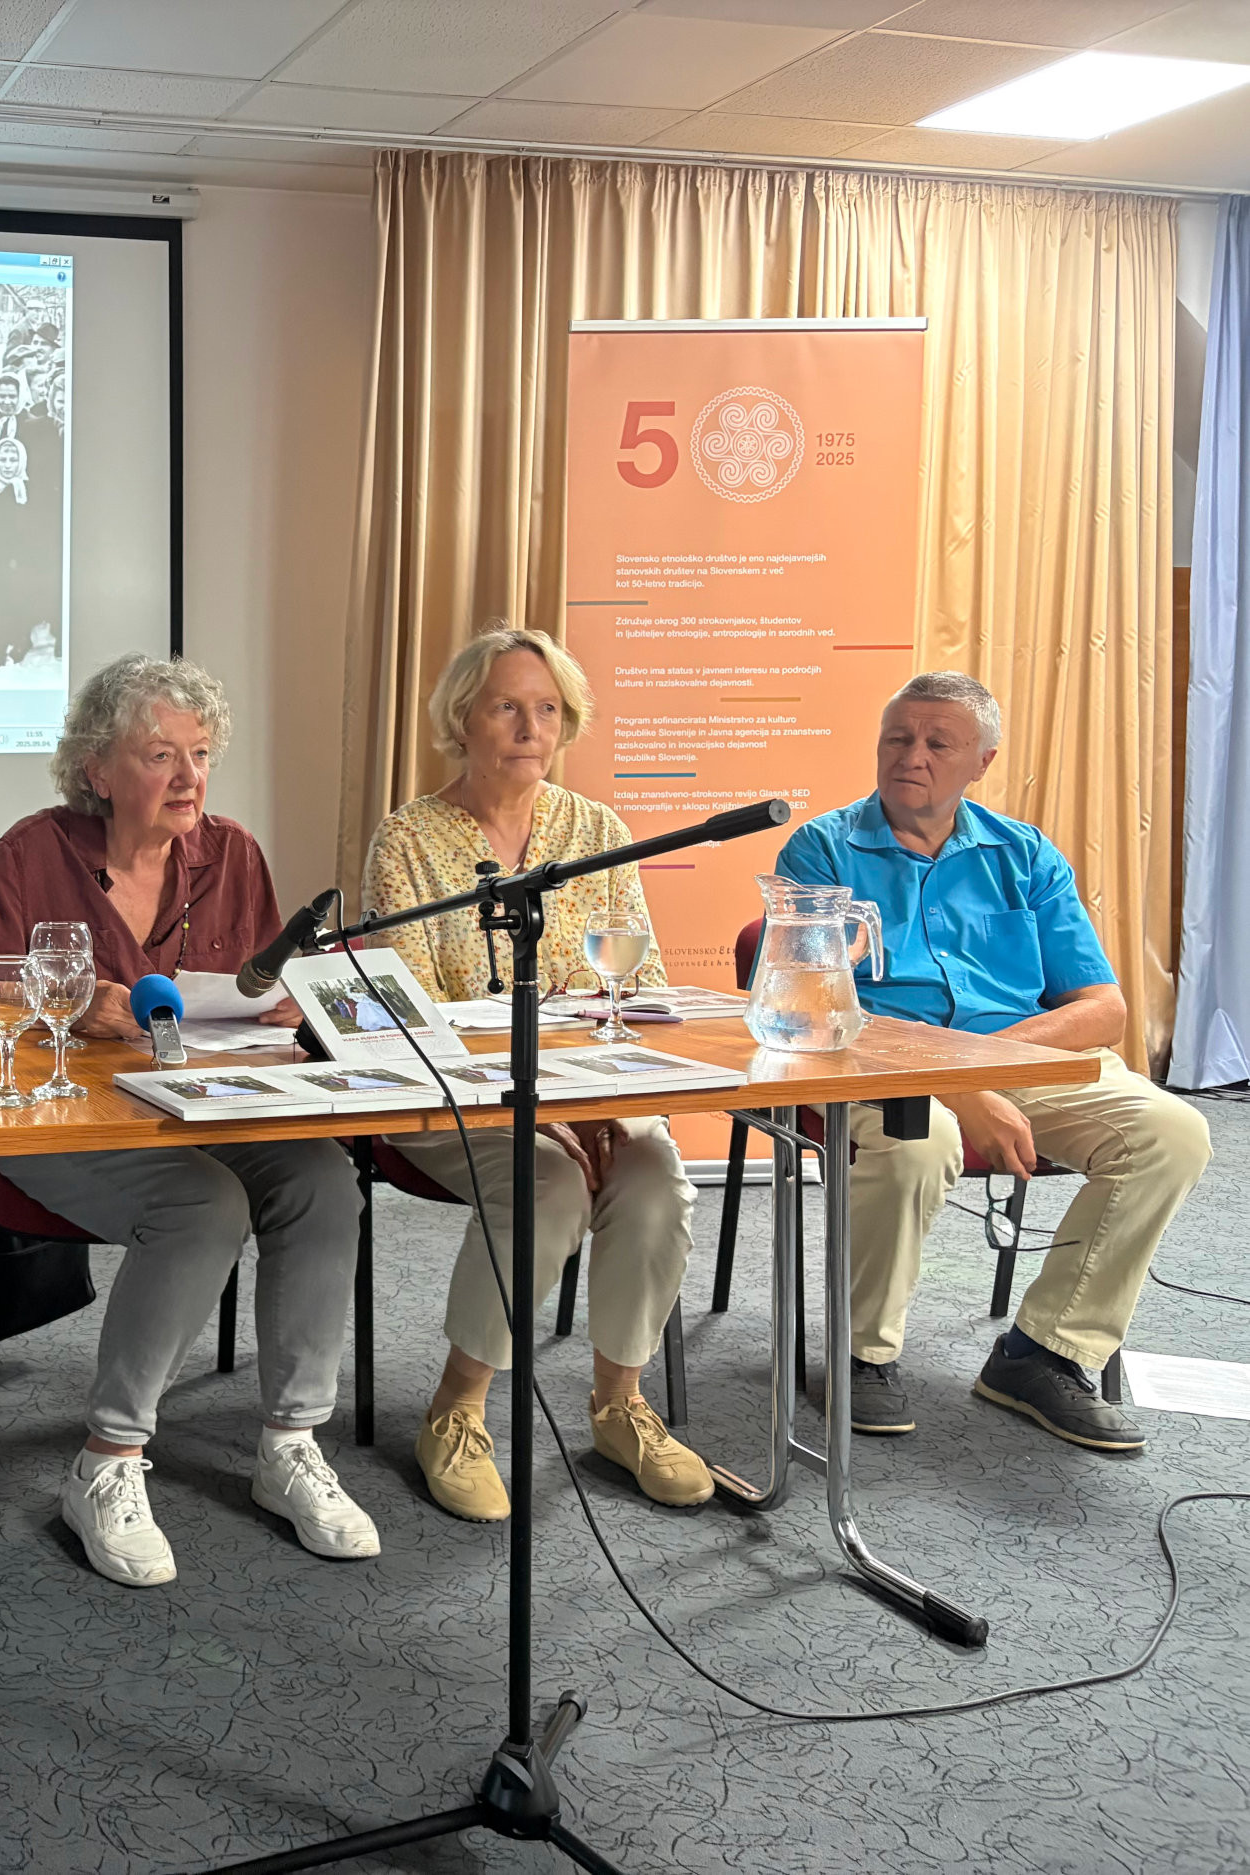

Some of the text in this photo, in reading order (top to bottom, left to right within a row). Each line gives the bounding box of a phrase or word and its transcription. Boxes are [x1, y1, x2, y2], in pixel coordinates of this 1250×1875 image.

[816, 433, 855, 447] 1975
[815, 452, 854, 466] 2025
[616, 554, 660, 563] Slovensko
[661, 554, 703, 563] etnološko
[705, 554, 738, 563] društvo
[739, 554, 747, 564] je
[766, 553, 827, 564] najdejavnejših
[616, 567, 661, 576] stanovskih
[663, 566, 695, 576] društev
[710, 567, 760, 575] Slovenskem
[769, 566, 784, 575] več
[616, 579, 705, 589] kot 50-letno tradicijo.
[615, 616, 801, 627] Združuje okrog 300 strokovnjakov, študentov
[615, 628, 835, 639] in ljubiteljev etnologije, antropologije in sorodnih ved.
[615, 666, 648, 675] Društvo
[650, 667, 665, 675] ima
[667, 667, 694, 675] status
[702, 666, 733, 677] javnem
[734, 666, 768, 674] interesu
[782, 666, 822, 676] področjih
[615, 678, 755, 689] kulture in raziskovalne dejavnosti.
[614, 716, 651, 726] Program
[652, 716, 707, 725] sofinancirata
[708, 715, 754, 724] Ministrstvo
[767, 715, 797, 724] kulturo
[614, 729, 657, 738] Republike
[658, 728, 697, 738] Slovenije
[698, 728, 706, 737] in
[708, 728, 733, 737] Javna
[734, 728, 769, 738] agencija
[783, 728, 832, 736] znanstveno
[614, 740, 767, 750] raziskovalno in inovacijsko dejavnost
[614, 753, 699, 763] Republike Slovenije.
[613, 789, 810, 800] Izdaja znanstveno-strokovno revijo Glasnik SED
[613, 803, 622, 812] in
[623, 803, 673, 813] monografije
[682, 803, 710, 812] sklopu
[664, 947, 717, 956] SLOVENSKO
